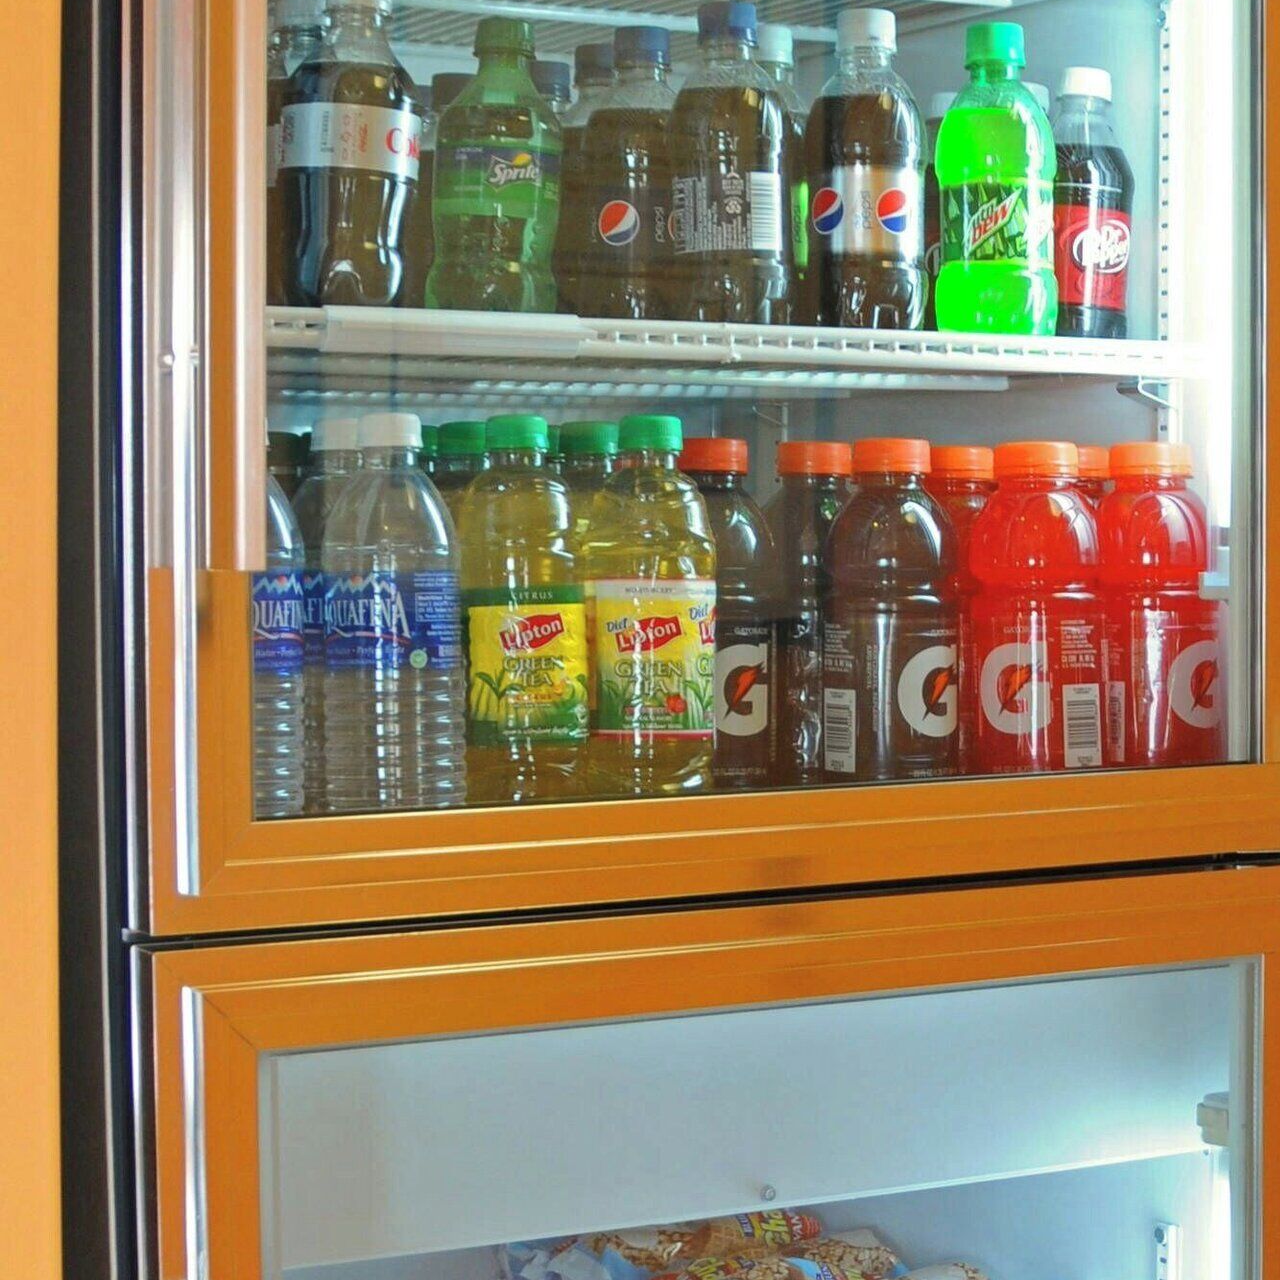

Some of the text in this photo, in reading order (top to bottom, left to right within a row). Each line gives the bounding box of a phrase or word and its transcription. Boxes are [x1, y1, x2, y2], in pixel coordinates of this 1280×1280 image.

[489, 161, 541, 186] Sprite
[504, 620, 563, 648] Lipton
[607, 617, 629, 633] Diet
[617, 622, 679, 649] Lipton
[503, 654, 565, 672] GREEN
[614, 658, 684, 678] GREEN
[519, 671, 554, 688] TEA
[980, 639, 1051, 735] G
